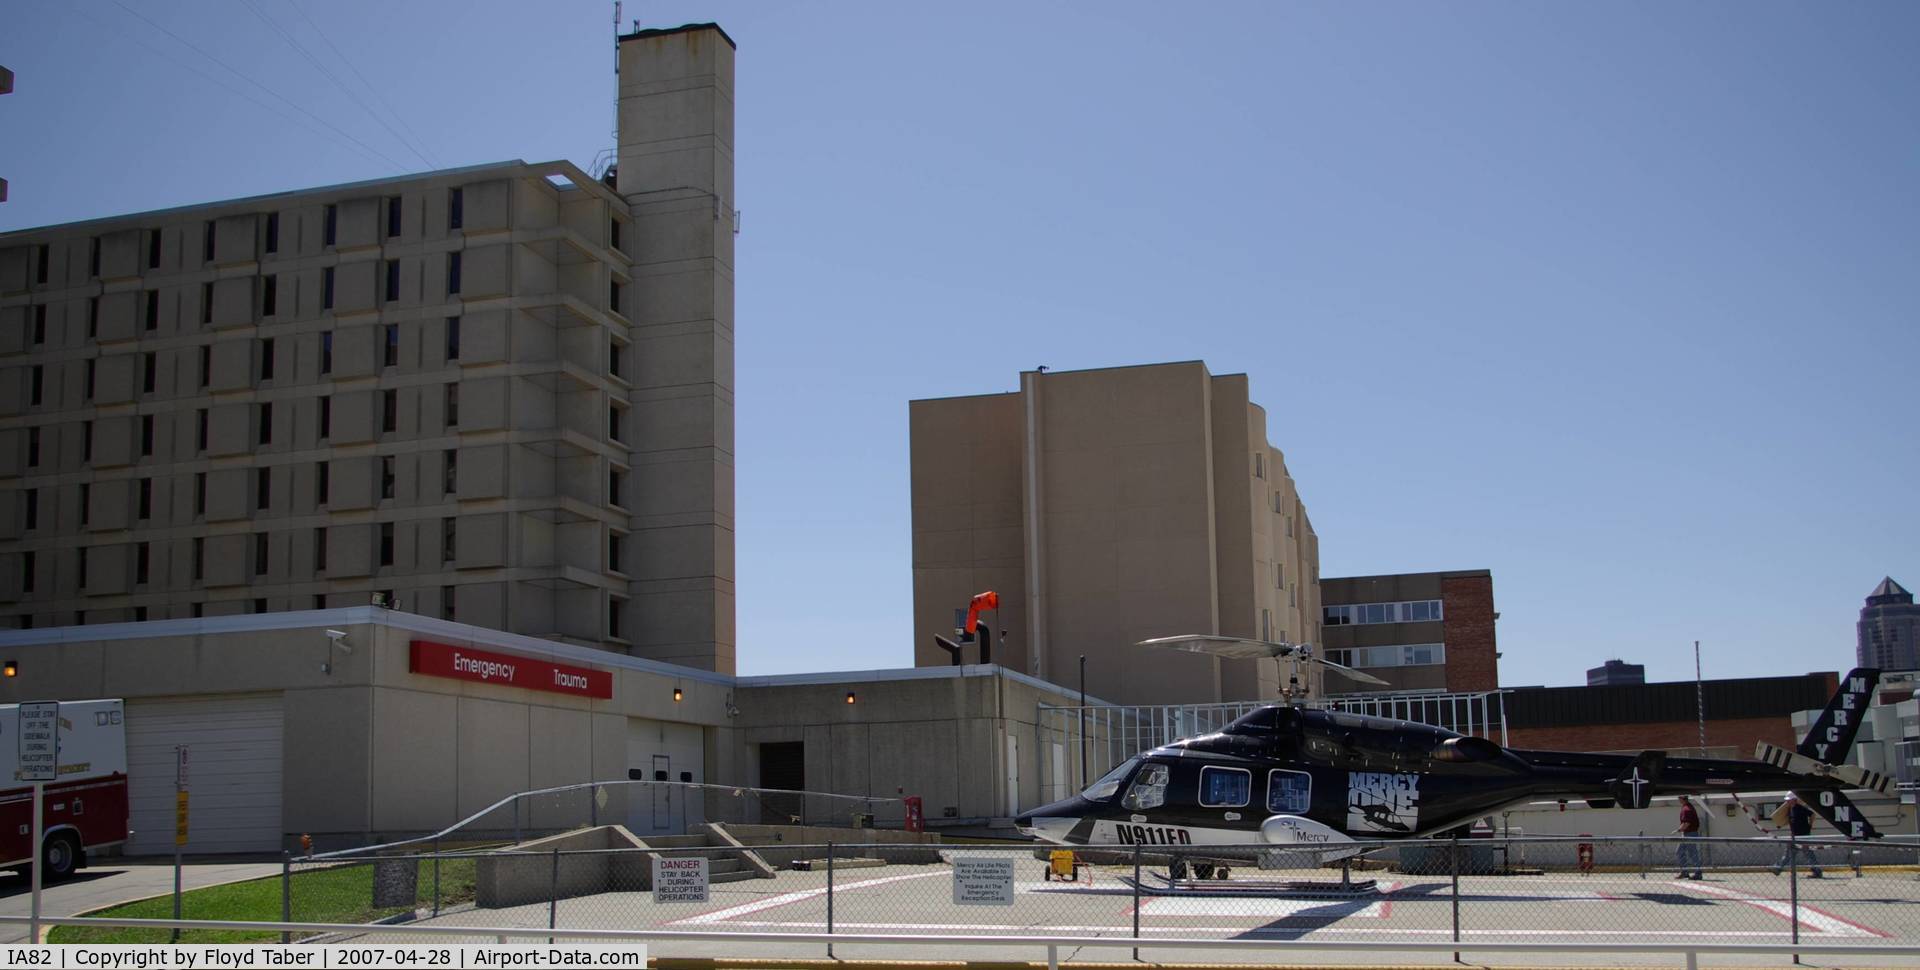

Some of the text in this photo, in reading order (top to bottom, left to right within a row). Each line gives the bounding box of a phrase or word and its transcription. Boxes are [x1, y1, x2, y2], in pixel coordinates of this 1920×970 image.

[454, 653, 587, 689] Emergency Trauma
[22, 710, 41, 718] PLEASE
[1815, 677, 1866, 760] MERCY
[1348, 772, 1419, 791] MERCY
[1819, 791, 1864, 838] ONE
[1297, 832, 1329, 843] Mercy
[660, 860, 700, 869] DANGER
[659, 893, 704, 901] OPERATIONS
